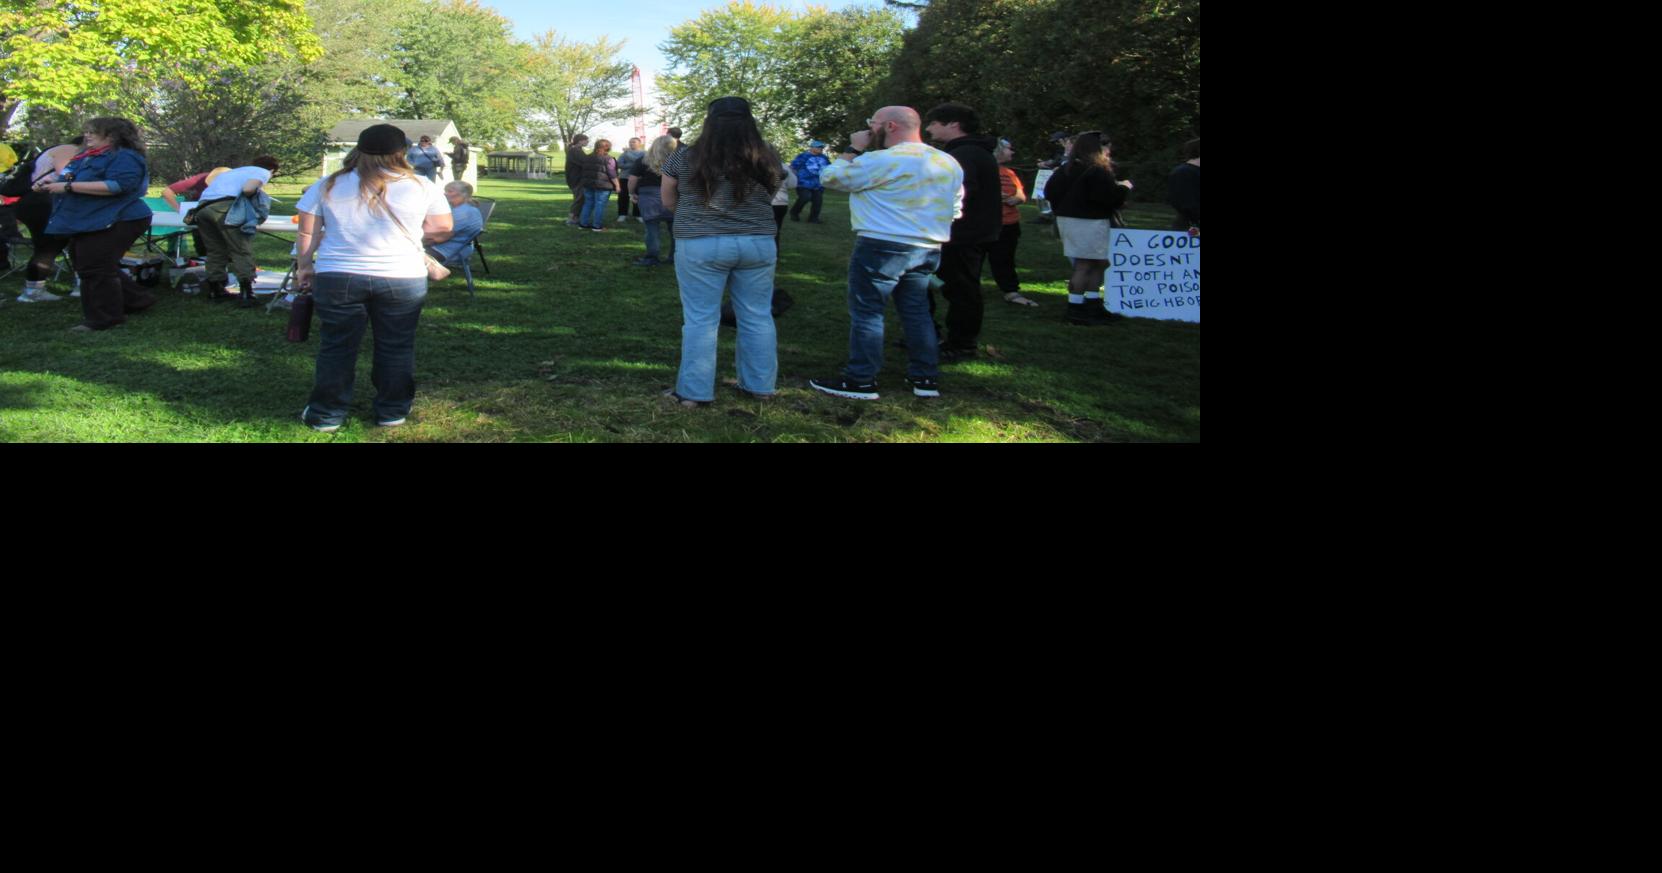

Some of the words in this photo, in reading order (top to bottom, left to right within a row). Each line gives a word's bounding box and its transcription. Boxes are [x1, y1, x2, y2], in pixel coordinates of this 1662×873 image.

[1115, 233, 1133, 248] A
[1148, 234, 1200, 249] GOOD
[1113, 253, 1195, 267] DOESNT
[1114, 270, 1174, 282] TOOTH
[1112, 285, 1144, 298] TOO
